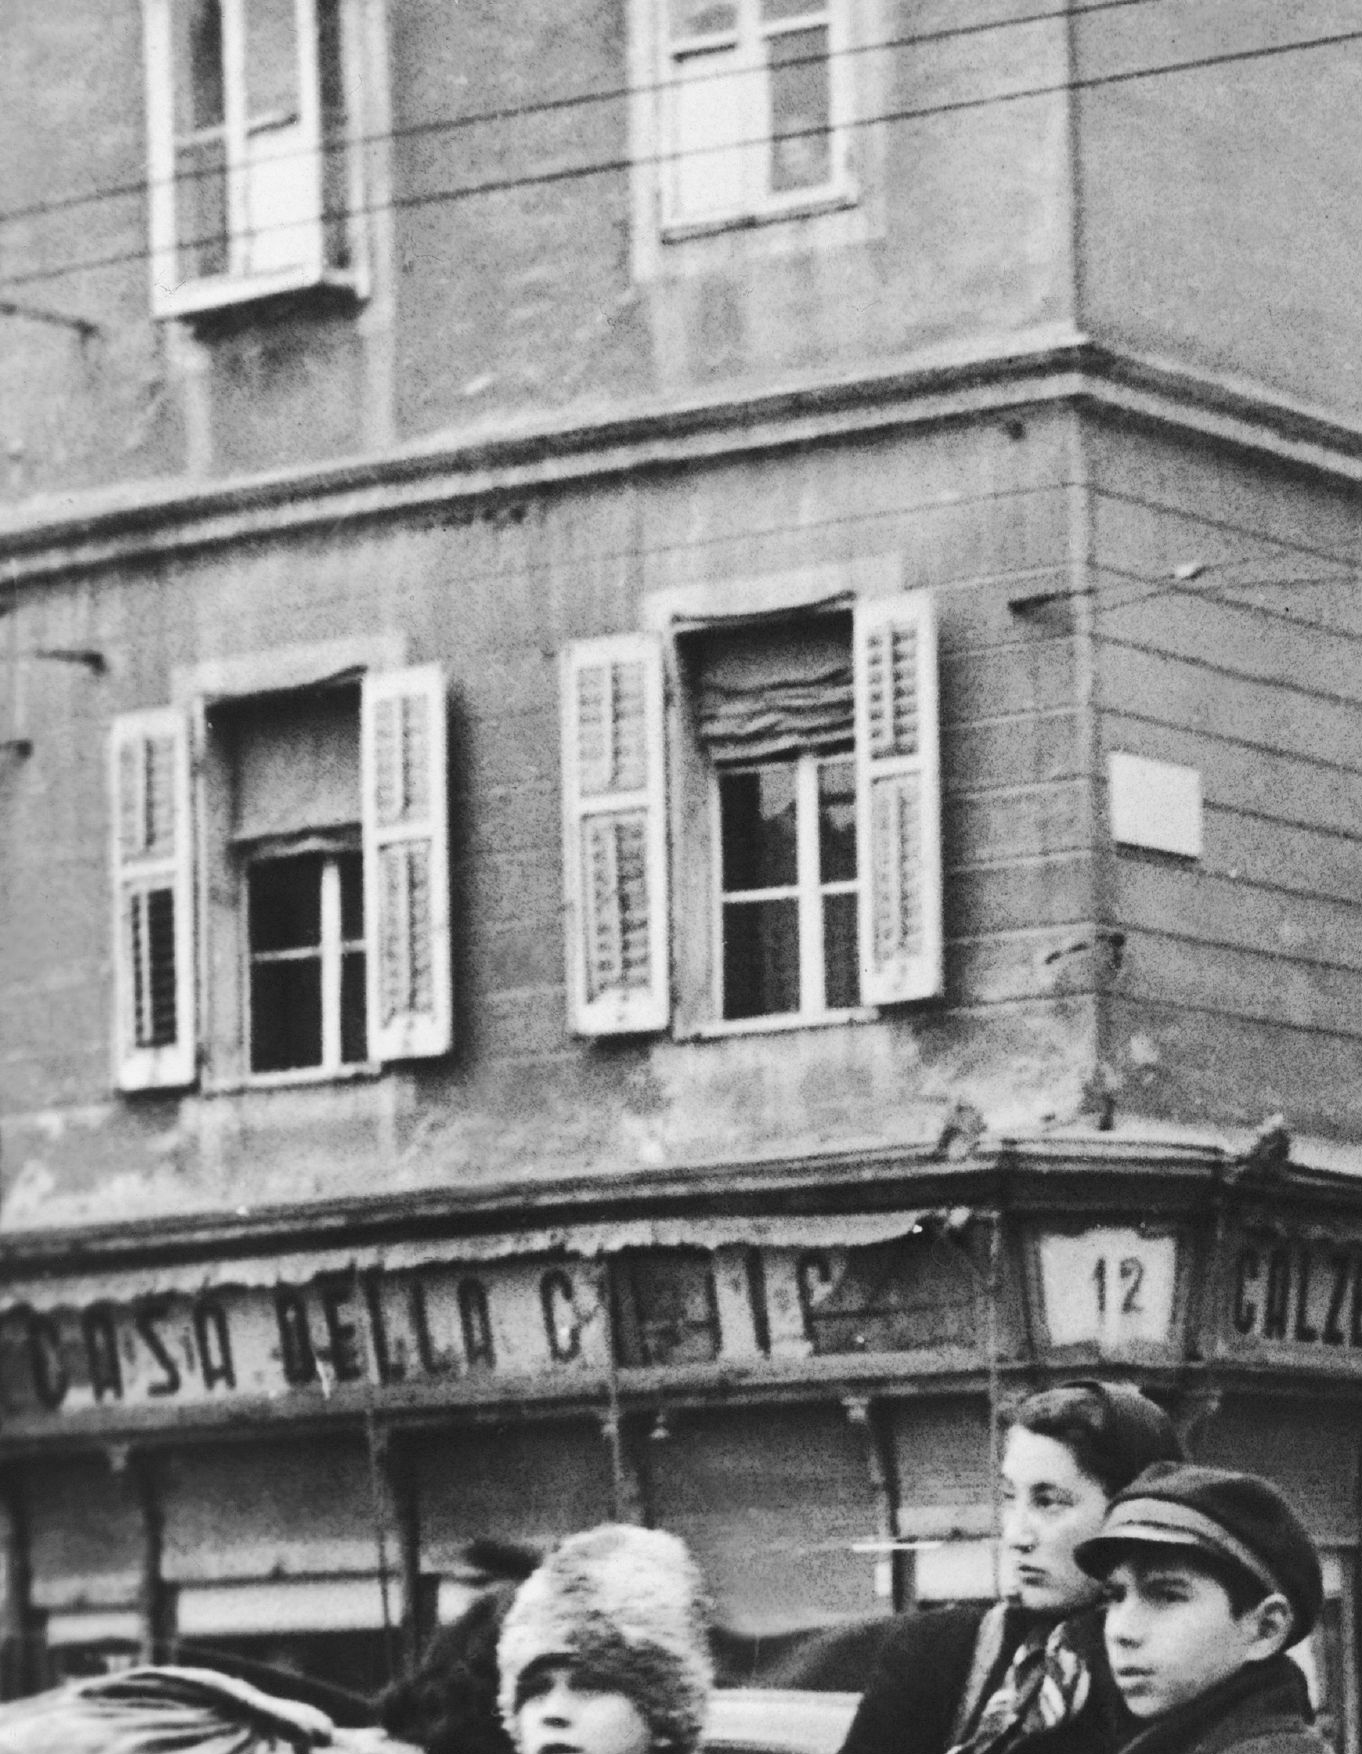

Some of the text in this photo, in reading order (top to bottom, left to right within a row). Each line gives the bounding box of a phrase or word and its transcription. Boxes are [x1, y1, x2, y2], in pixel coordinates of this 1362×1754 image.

[1092, 1256, 1144, 1315] 12
[28, 1286, 238, 1407] CASA
[276, 1268, 496, 1385] DELLA
